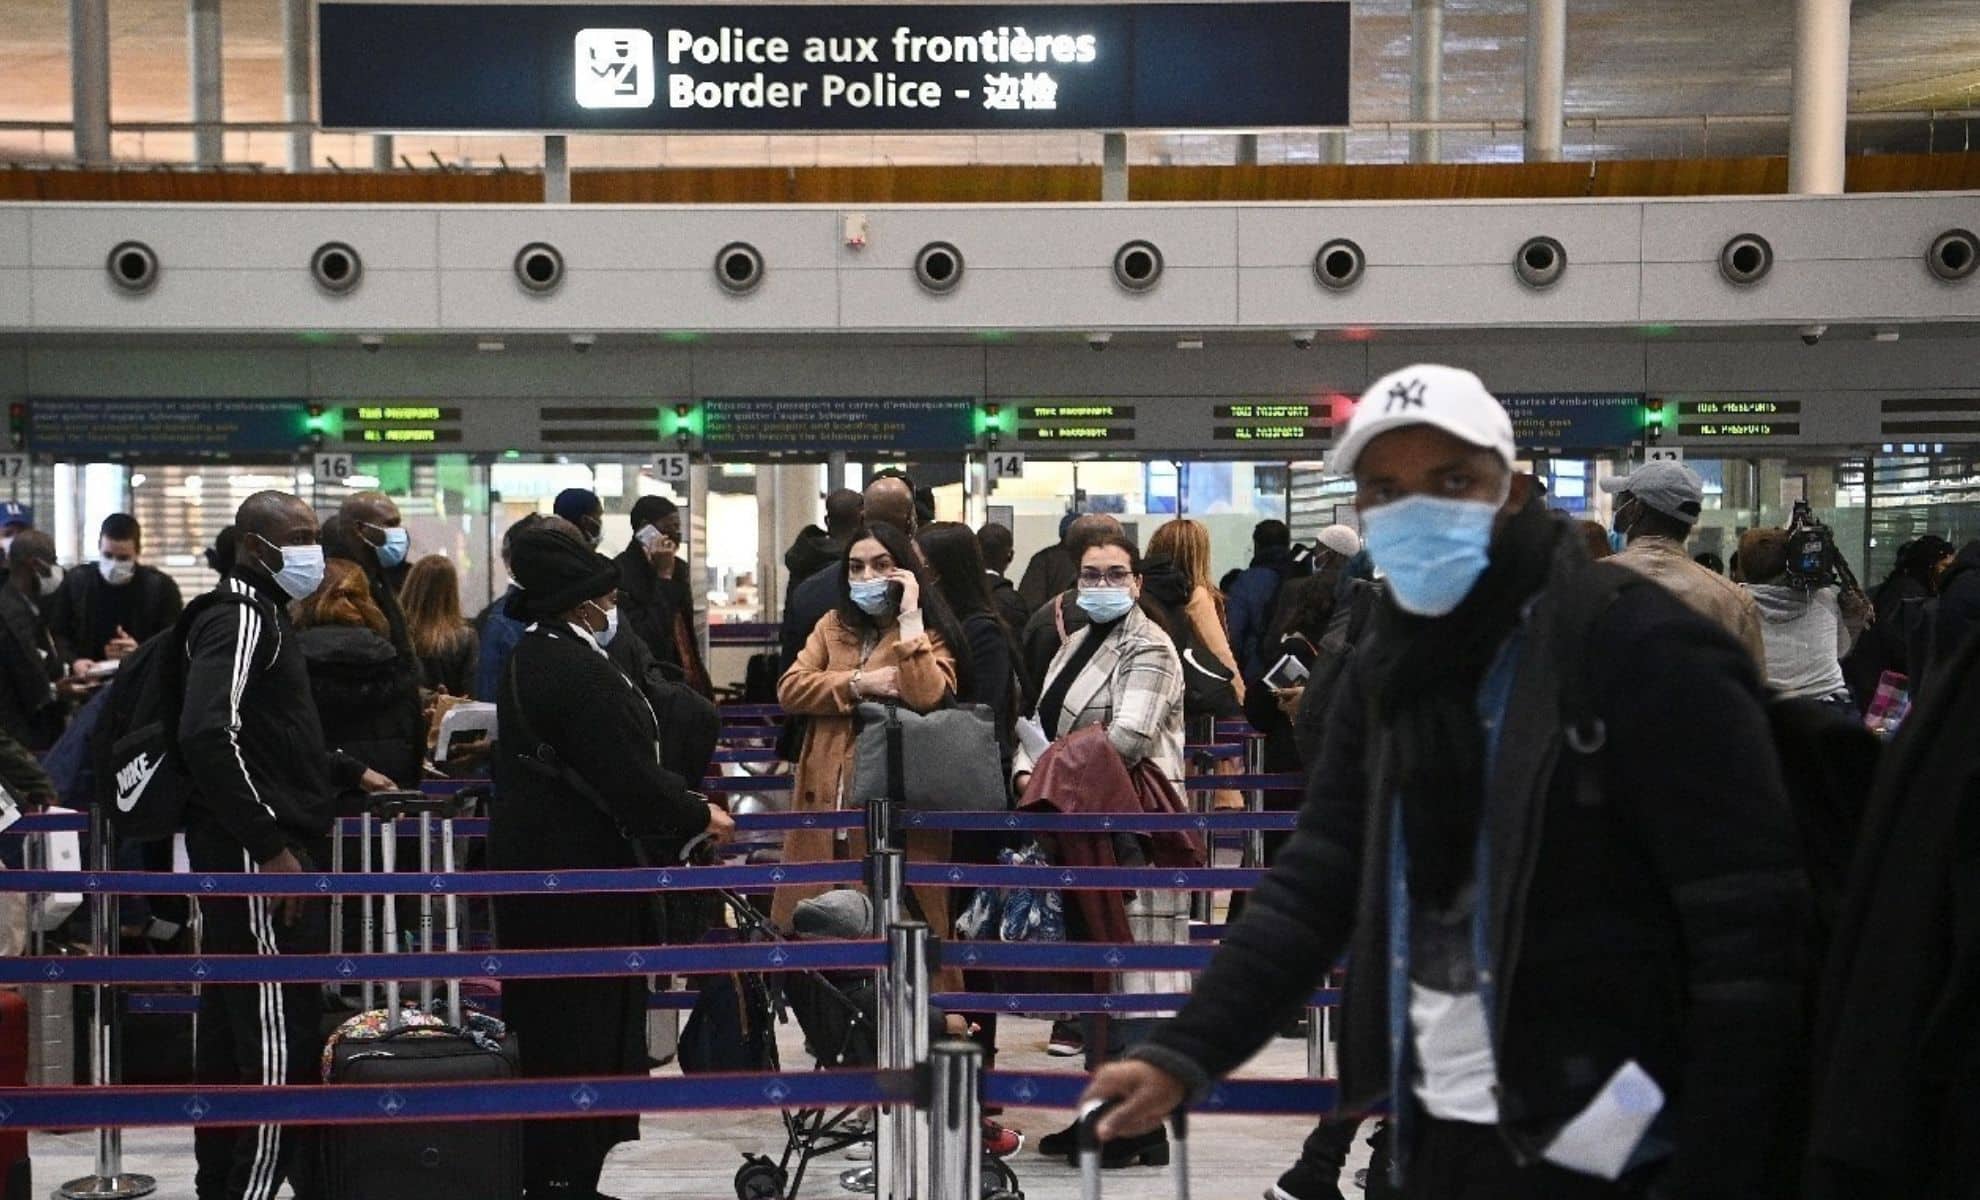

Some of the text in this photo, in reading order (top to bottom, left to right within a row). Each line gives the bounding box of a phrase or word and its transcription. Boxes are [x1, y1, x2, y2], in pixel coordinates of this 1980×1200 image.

[667, 26, 1096, 64] Police aux frontières
[668, 72, 808, 108] Border
[822, 72, 942, 108] Police
[0, 458, 22, 476] 17
[321, 457, 347, 478] 16
[657, 457, 683, 476] 15
[994, 456, 1020, 476] 14
[115, 752, 150, 795] NIKE
